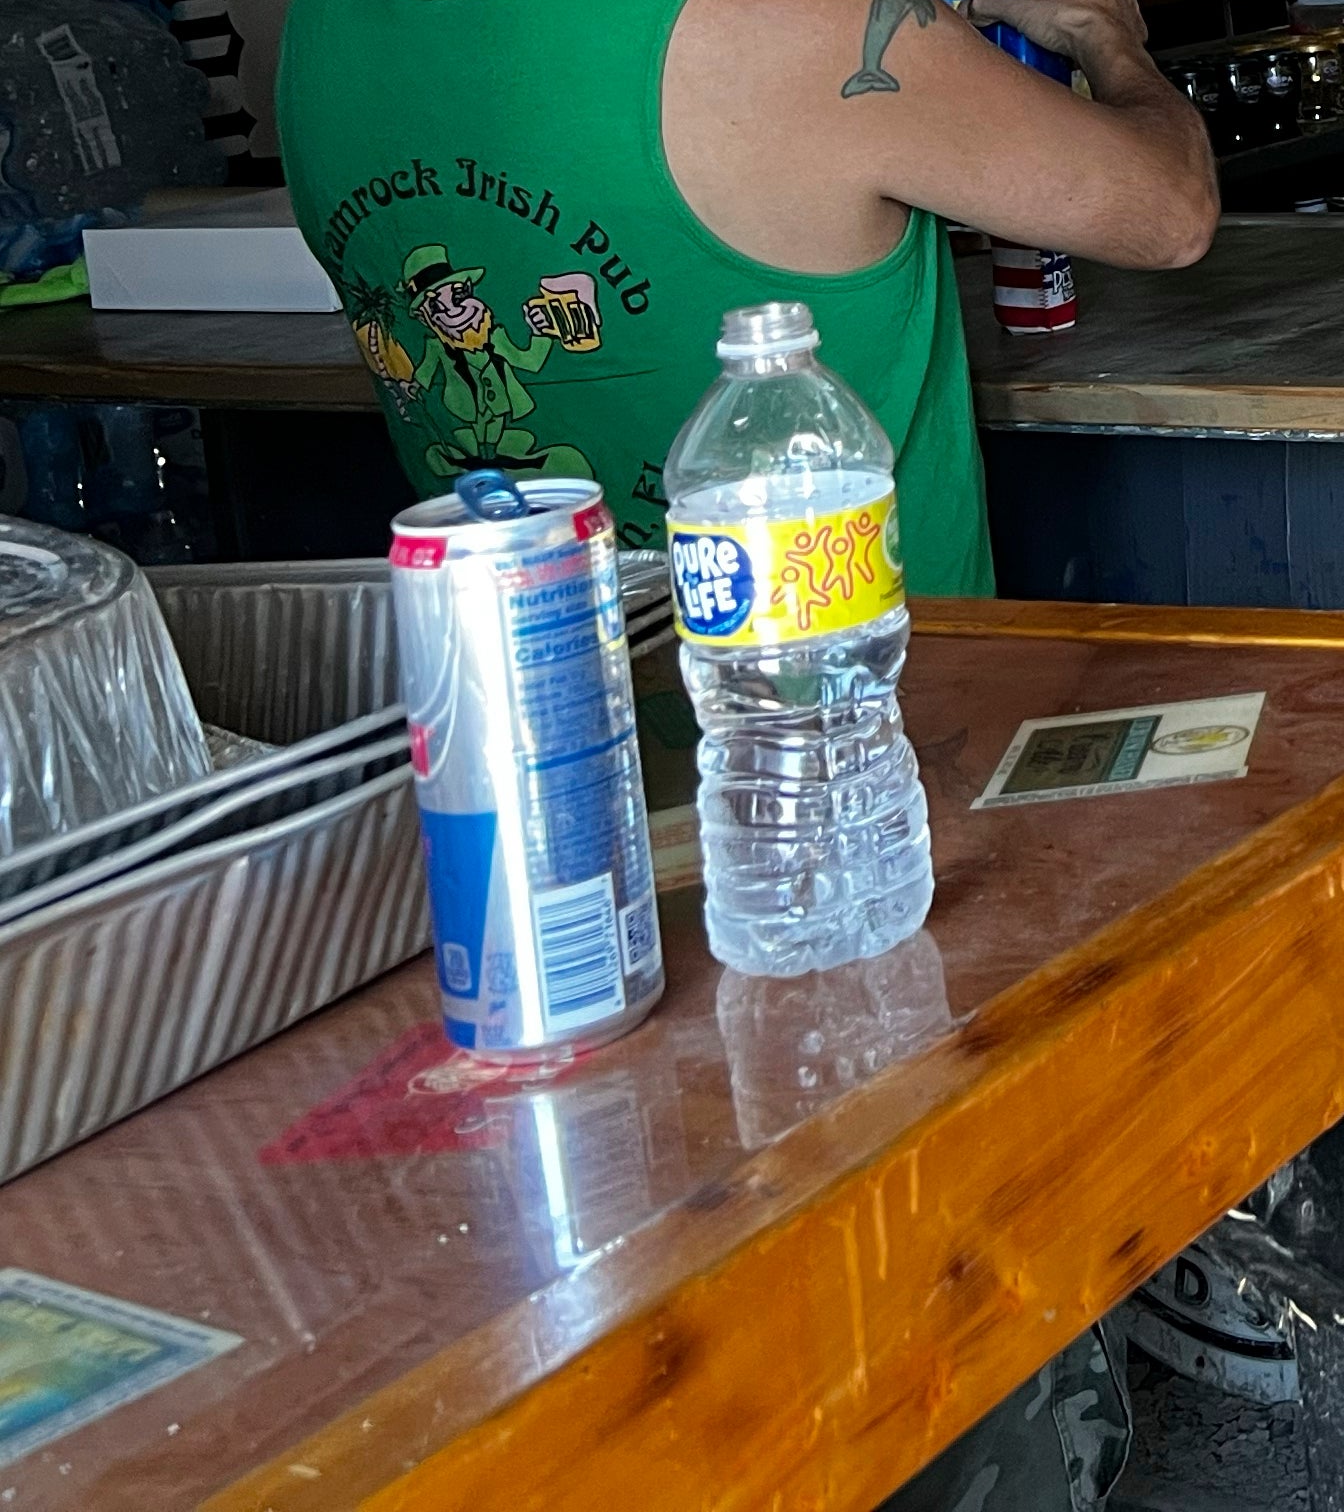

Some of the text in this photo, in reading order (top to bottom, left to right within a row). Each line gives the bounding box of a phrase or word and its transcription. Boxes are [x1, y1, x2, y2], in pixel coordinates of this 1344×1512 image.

[326, 157, 652, 316] amrock Irish Pub
